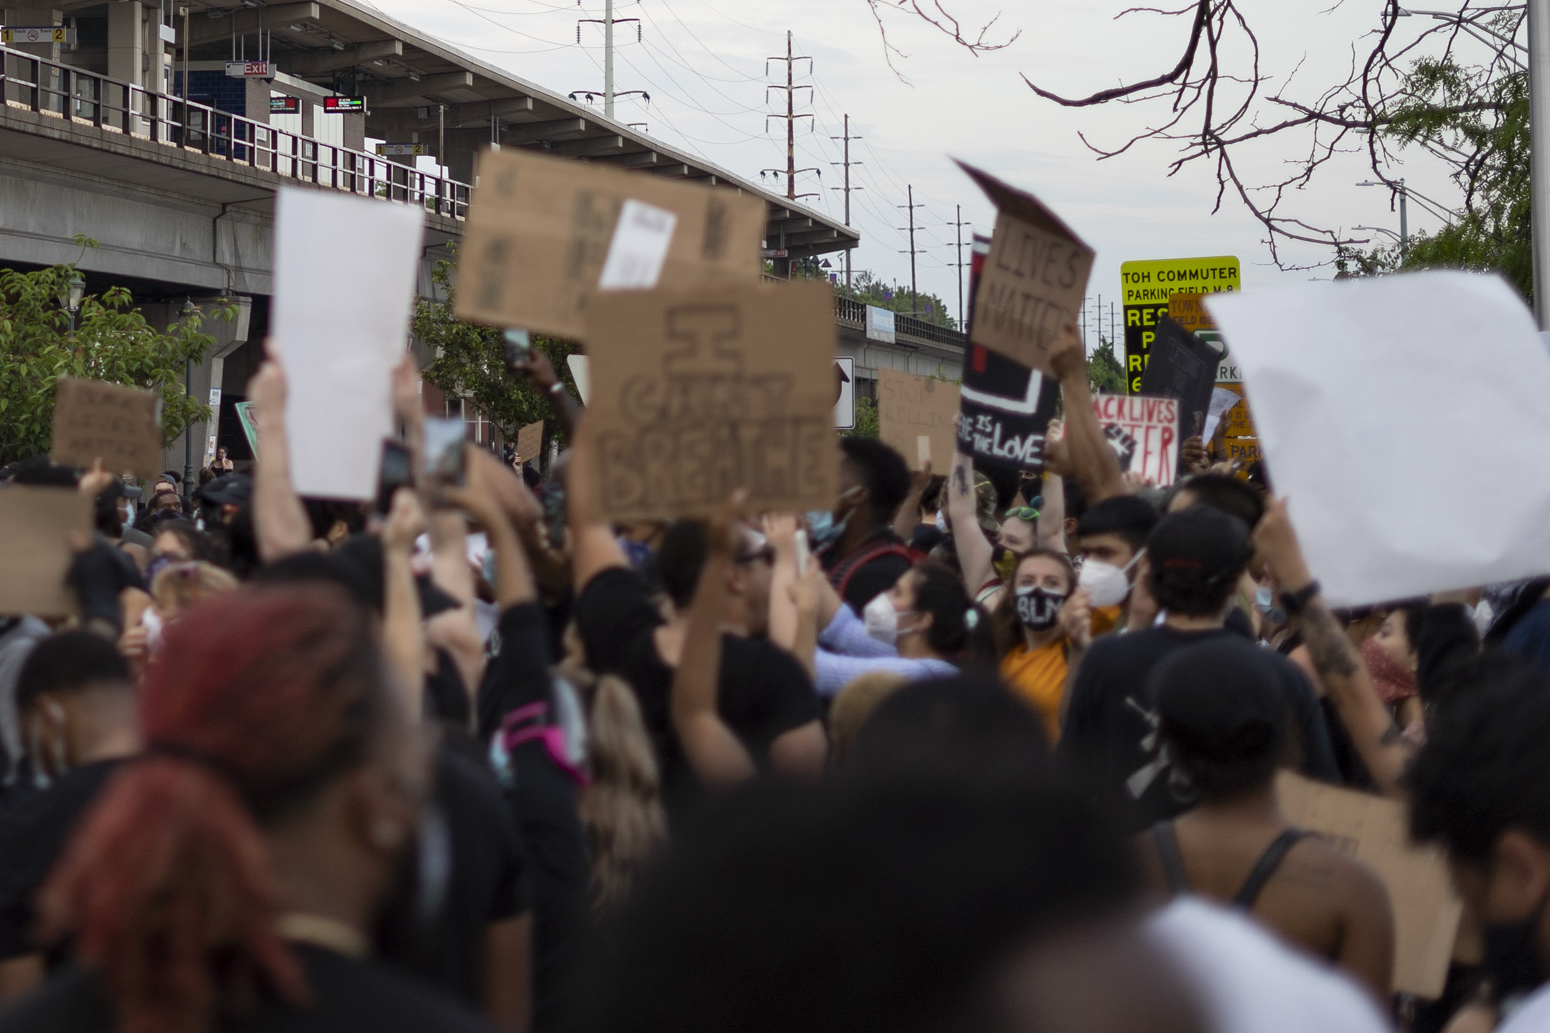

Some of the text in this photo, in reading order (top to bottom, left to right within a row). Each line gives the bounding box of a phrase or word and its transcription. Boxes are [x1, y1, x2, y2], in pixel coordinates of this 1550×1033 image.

[3, 29, 9, 40] 1
[55, 29, 63, 40] 2
[244, 63, 267, 74] Exit
[415, 145, 421, 153] 2
[996, 221, 1081, 289] LIVES
[1123, 267, 1238, 284] TOH COMMUTER
[663, 303, 744, 377] I
[1093, 396, 1175, 424] ACK LIVES
[976, 415, 992, 432] IS
[973, 433, 993, 455] THE
[992, 422, 1045, 464] LOVE
